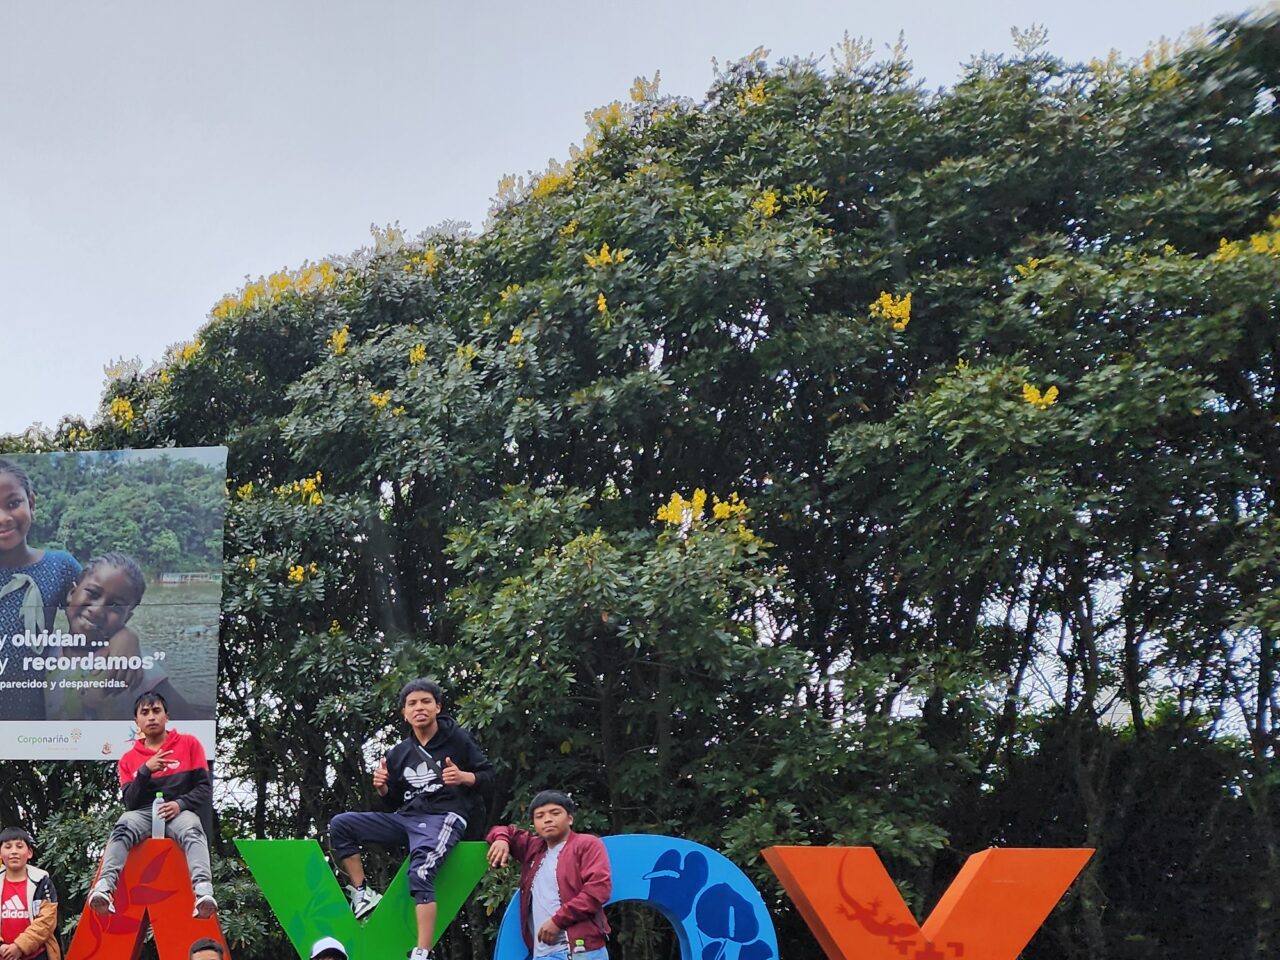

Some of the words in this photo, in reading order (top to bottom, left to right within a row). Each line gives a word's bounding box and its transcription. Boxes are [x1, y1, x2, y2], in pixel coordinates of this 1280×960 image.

[12, 629, 86, 648] olvidan
[50, 682, 57, 691] y
[59, 679, 128, 690] desparecidas.
[18, 735, 69, 744] Corponariño
[1, 909, 29, 919] adidas
